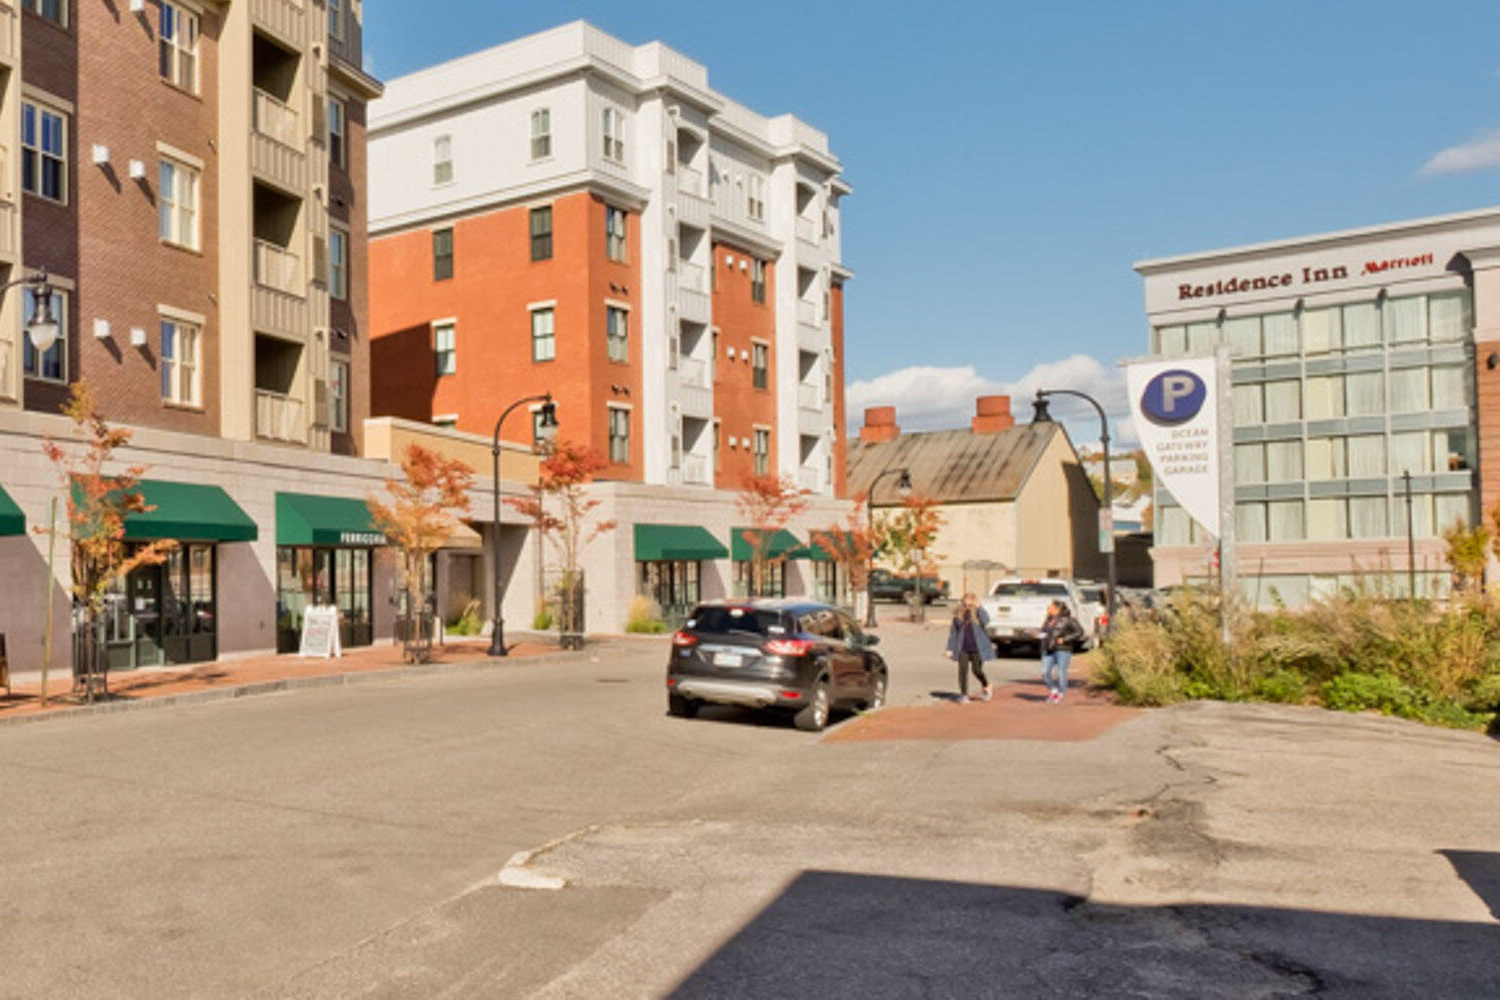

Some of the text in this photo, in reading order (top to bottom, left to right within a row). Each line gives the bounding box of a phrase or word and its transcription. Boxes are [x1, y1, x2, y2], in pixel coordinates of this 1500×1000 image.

[1178, 252, 1434, 300] Residence Inn Marriott
[1163, 375, 1195, 412] P
[1171, 428, 1209, 439] OCEAN
[1160, 453, 1209, 464] PARKING
